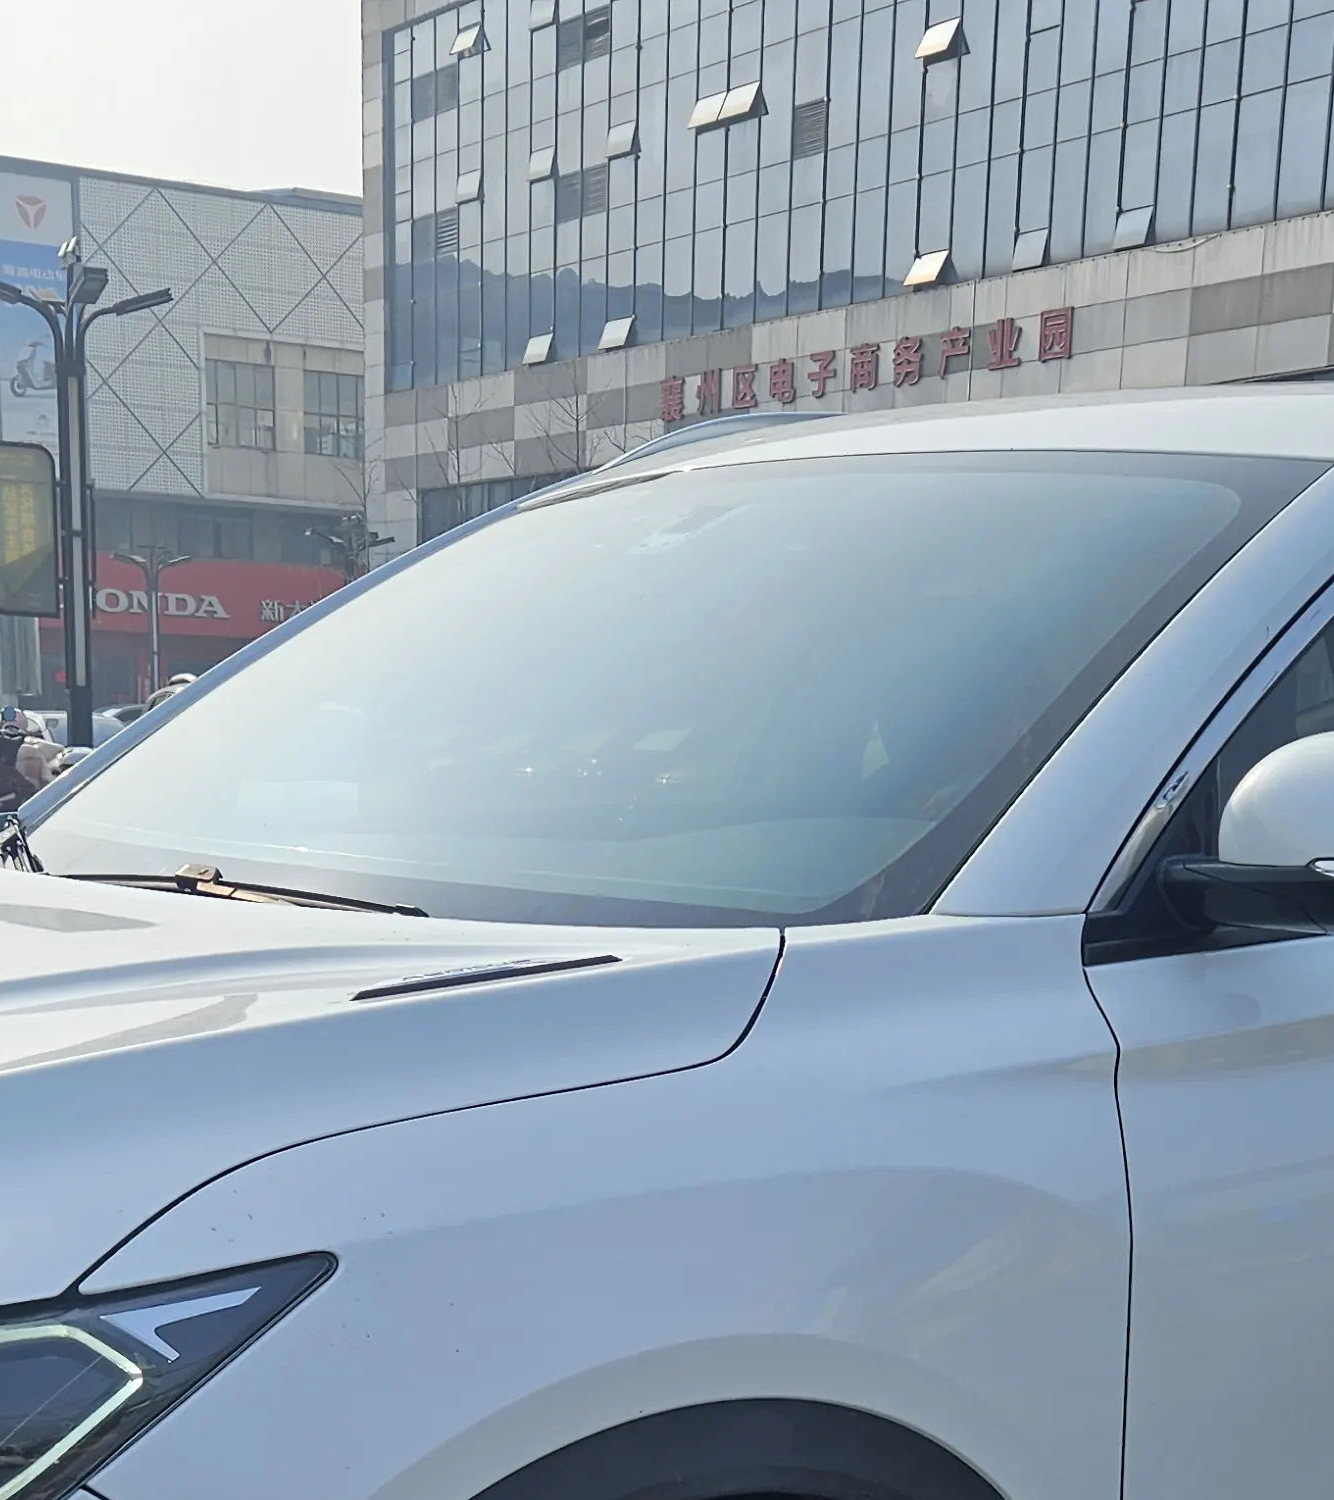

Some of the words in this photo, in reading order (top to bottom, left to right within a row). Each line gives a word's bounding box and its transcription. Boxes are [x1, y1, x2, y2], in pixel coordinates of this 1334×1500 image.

[658, 305, 1075, 423] 襄州区电子商务产业园
[96, 587, 230, 620] ONDA
